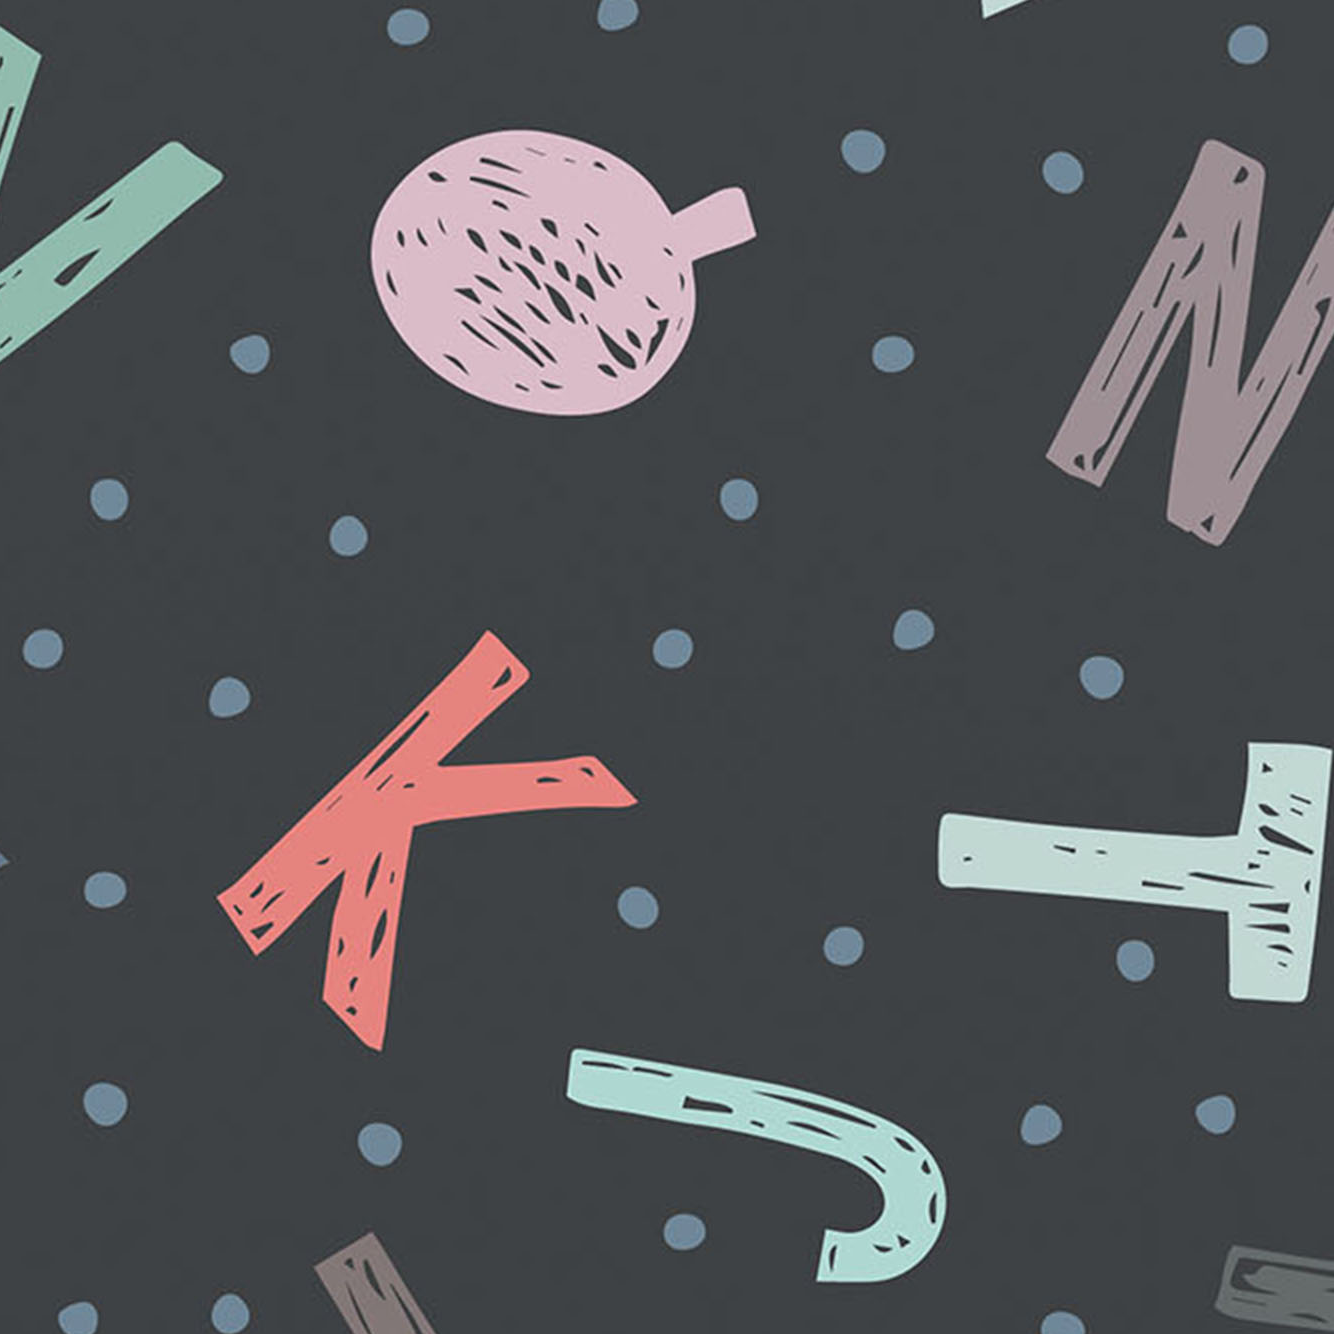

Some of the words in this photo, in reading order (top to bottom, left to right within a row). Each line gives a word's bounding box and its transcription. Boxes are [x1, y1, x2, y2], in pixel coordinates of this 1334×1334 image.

[1045, 139, 1334, 546] N
[216, 628, 639, 1052] K
[938, 741, 1333, 1003] T
[566, 1048, 947, 1283] J
